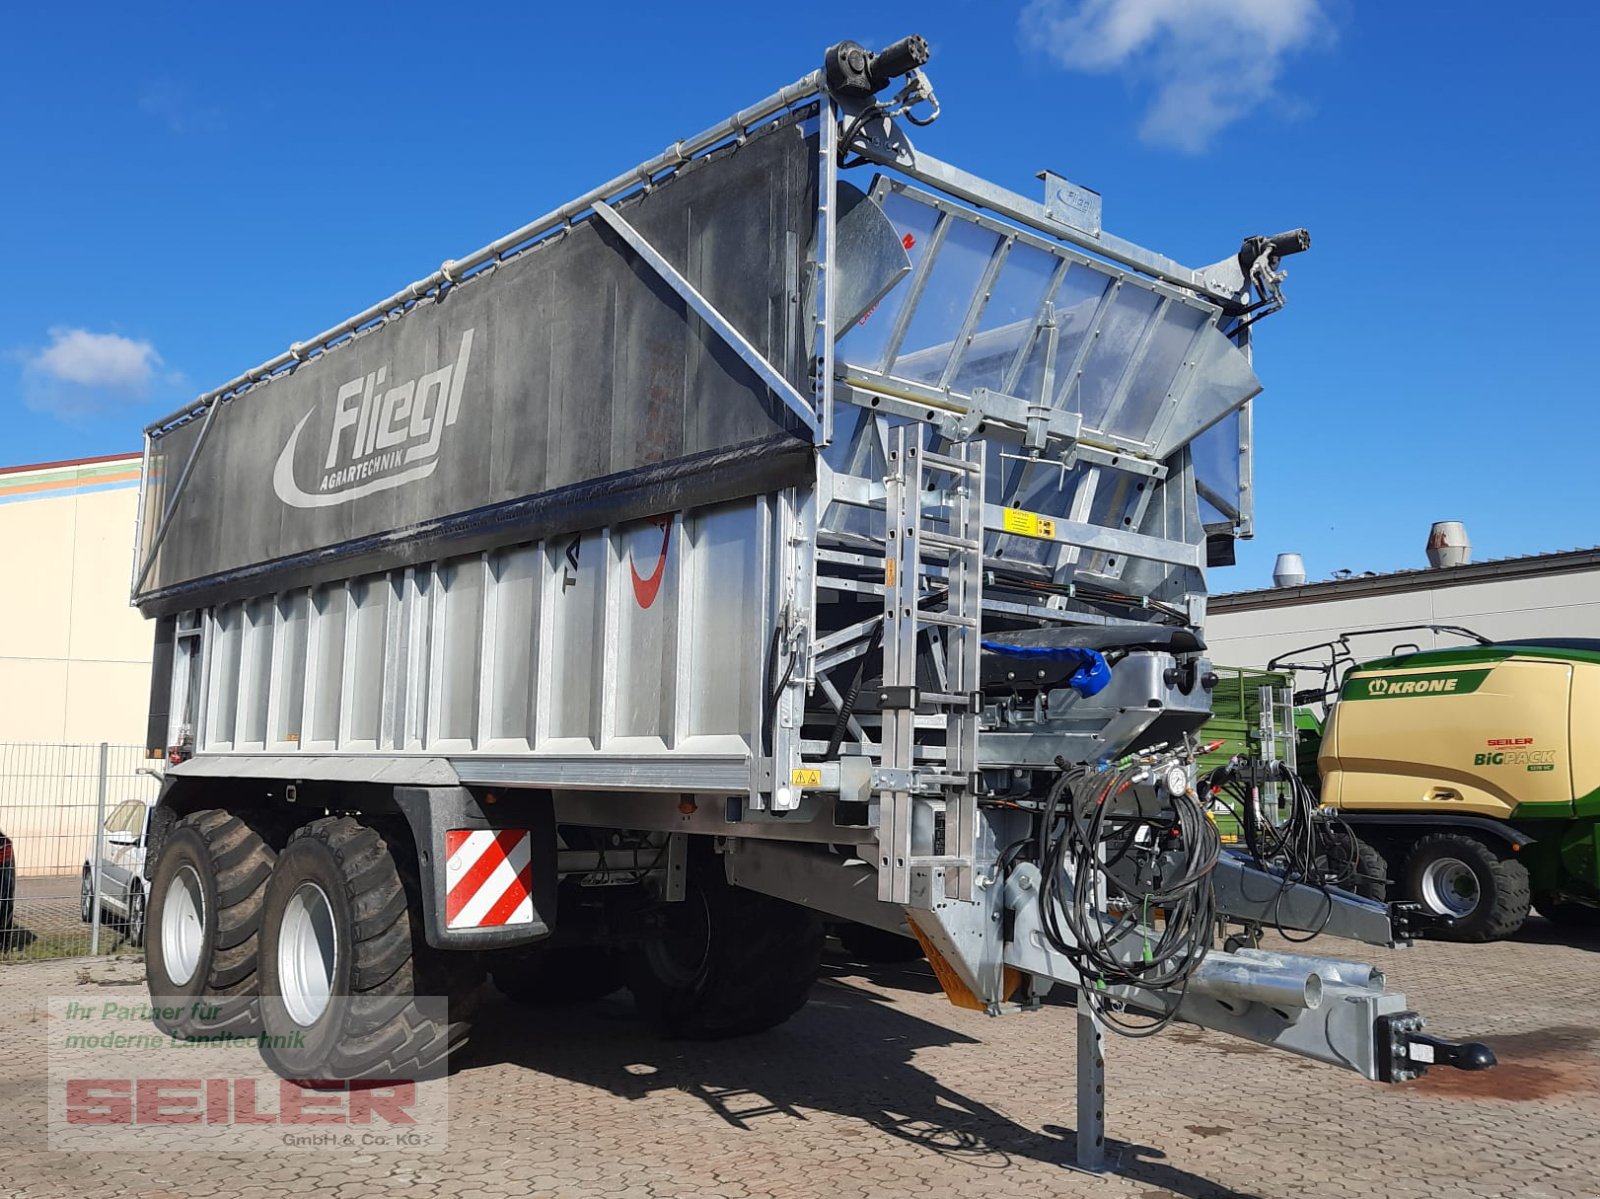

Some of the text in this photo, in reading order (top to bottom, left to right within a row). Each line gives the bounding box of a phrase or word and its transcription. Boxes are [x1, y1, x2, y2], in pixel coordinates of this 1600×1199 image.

[325, 328, 474, 469] Fliegl
[320, 449, 404, 491] AGRARTECHNIK
[1387, 678, 1458, 694] KRONE
[1487, 737, 1533, 746] SEILER
